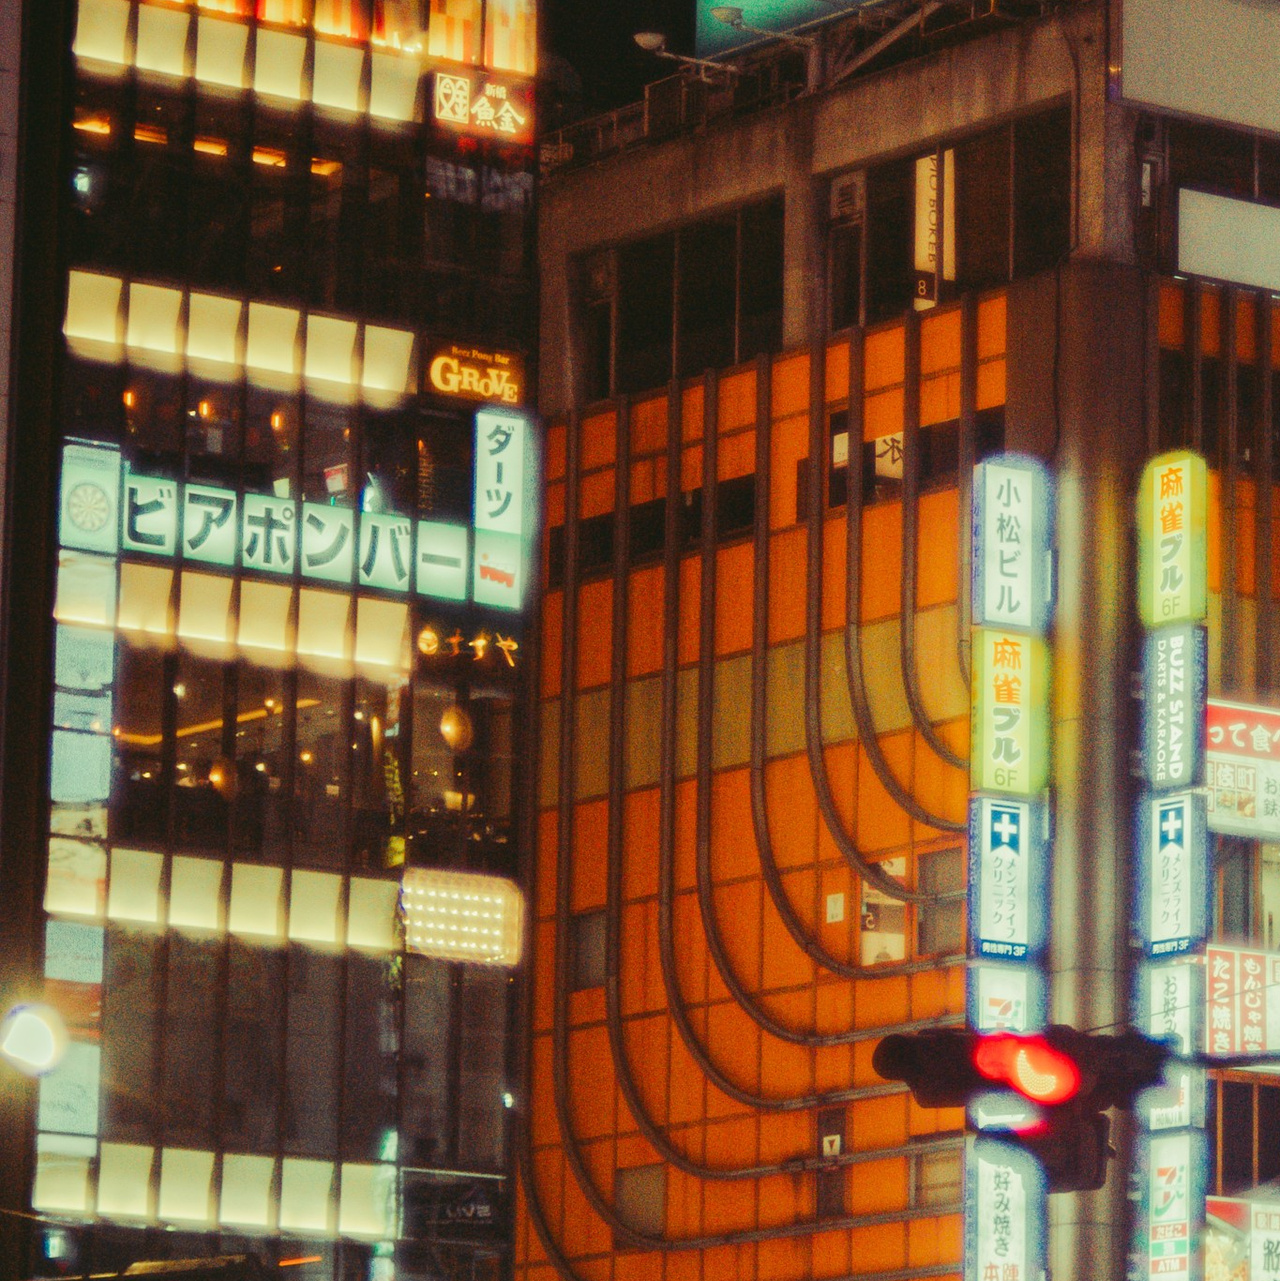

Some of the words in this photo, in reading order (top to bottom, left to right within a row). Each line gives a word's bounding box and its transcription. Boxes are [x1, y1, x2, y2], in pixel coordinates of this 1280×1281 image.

[471, 96, 525, 133] 魚金
[430, 355, 519, 403] GROVE
[486, 423, 516, 520] ダーツ
[126, 486, 462, 583] ビアポンバー
[996, 478, 1022, 615] 小松ビル
[1160, 467, 1184, 593] 麻雀ブル
[1162, 595, 1181, 616] 6F
[1157, 639, 1167, 689] DARTS
[1169, 634, 1184, 695] BUZZ
[991, 637, 1022, 765] 麻雀ブル
[1156, 707, 1167, 781] KARAOKE
[1169, 696, 1184, 779] STAND
[994, 768, 1018, 787] 6F
[992, 856, 1003, 925] クリニック
[1005, 857, 1017, 939] メンズライフ
[1162, 855, 1171, 924] クリニック
[1172, 853, 1181, 936] メンズライフ
[1013, 944, 1026, 958] 3F
[1178, 938, 1190, 952] 3F
[1212, 956, 1232, 1053] たこ焼き
[993, 1165, 1011, 1257] 好み焼き
[1157, 1257, 1181, 1273] ATM
